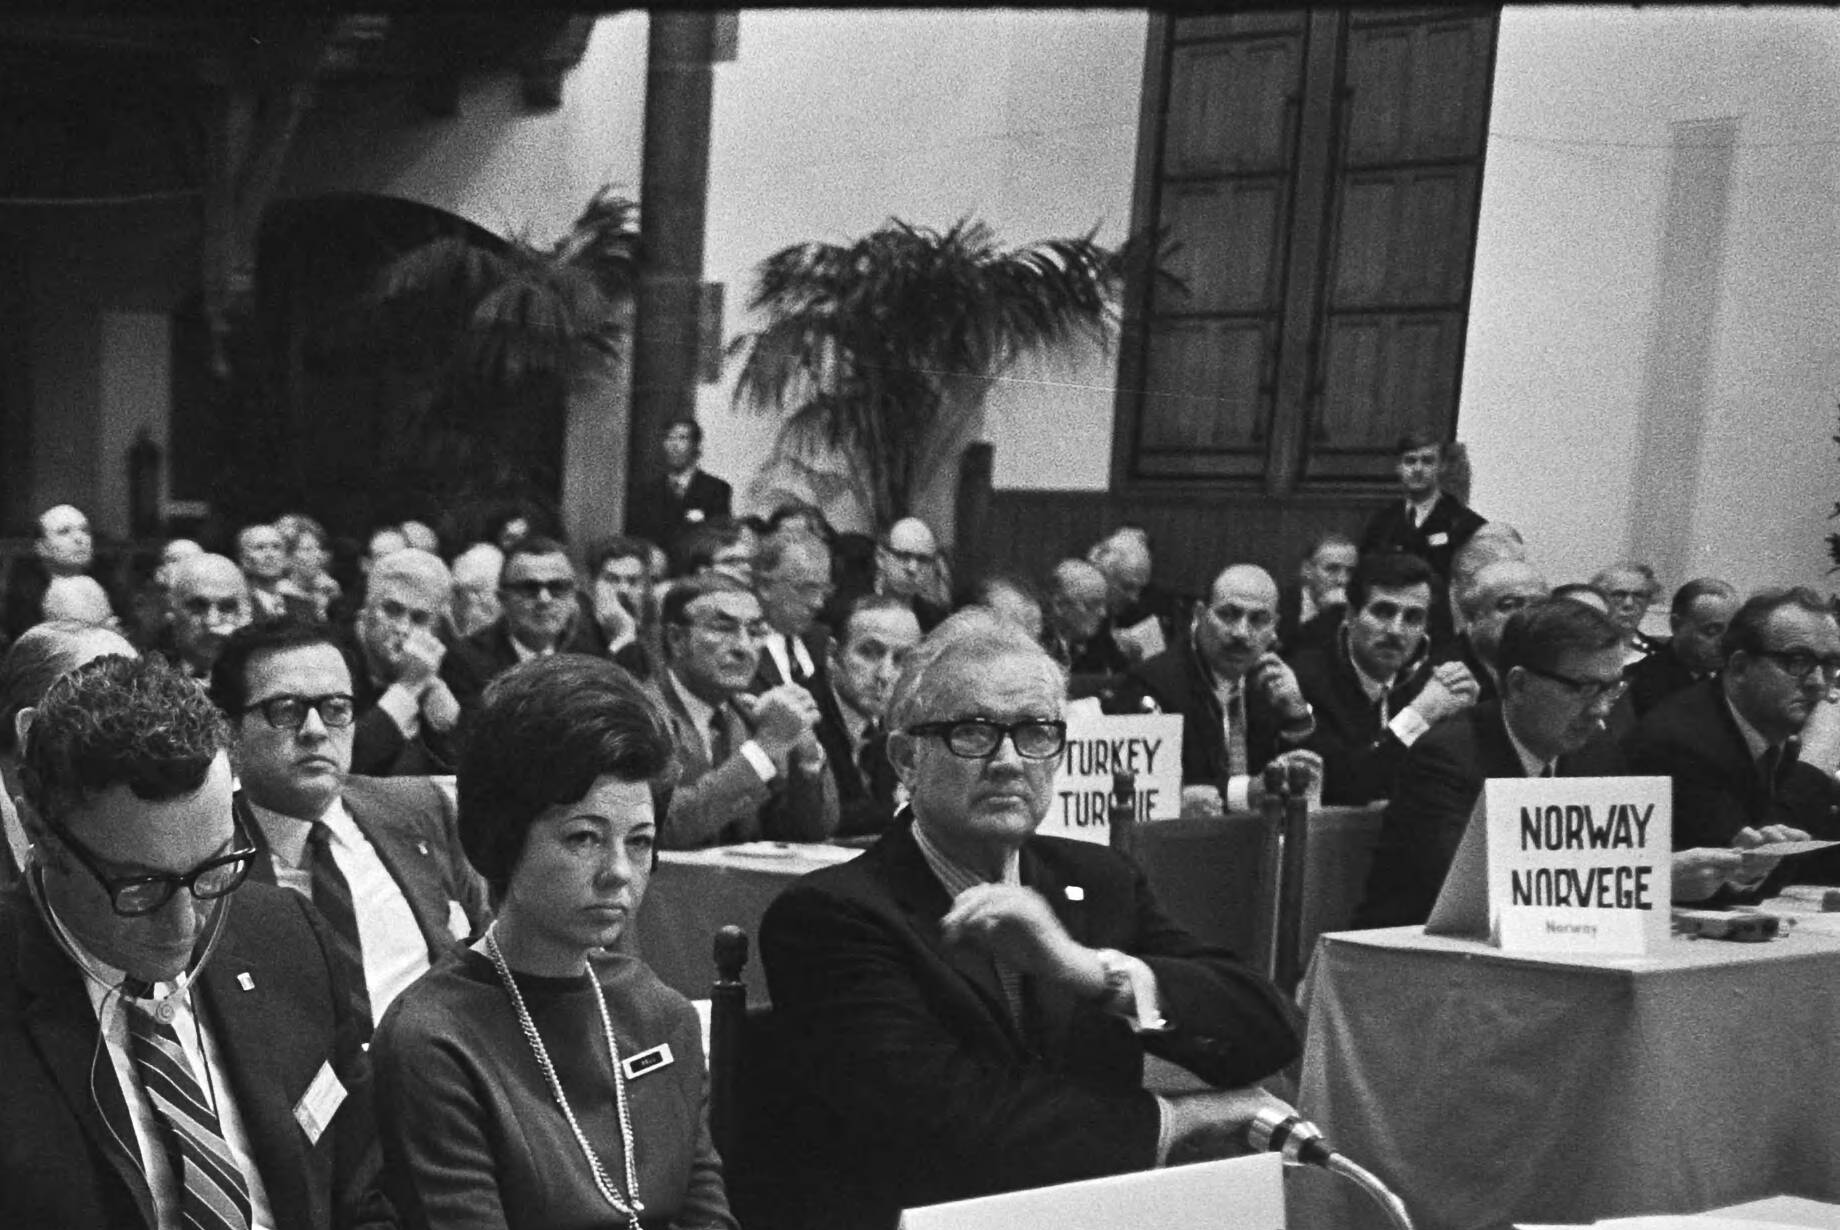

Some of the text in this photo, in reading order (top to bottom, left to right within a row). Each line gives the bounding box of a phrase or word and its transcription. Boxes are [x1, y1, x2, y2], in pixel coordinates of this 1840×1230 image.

[1067, 739, 1162, 776] TURKEY
[1520, 803, 1655, 851] NORWAY
[1511, 865, 1653, 910] NORVEGE
[1545, 920, 1598, 938] Norway
